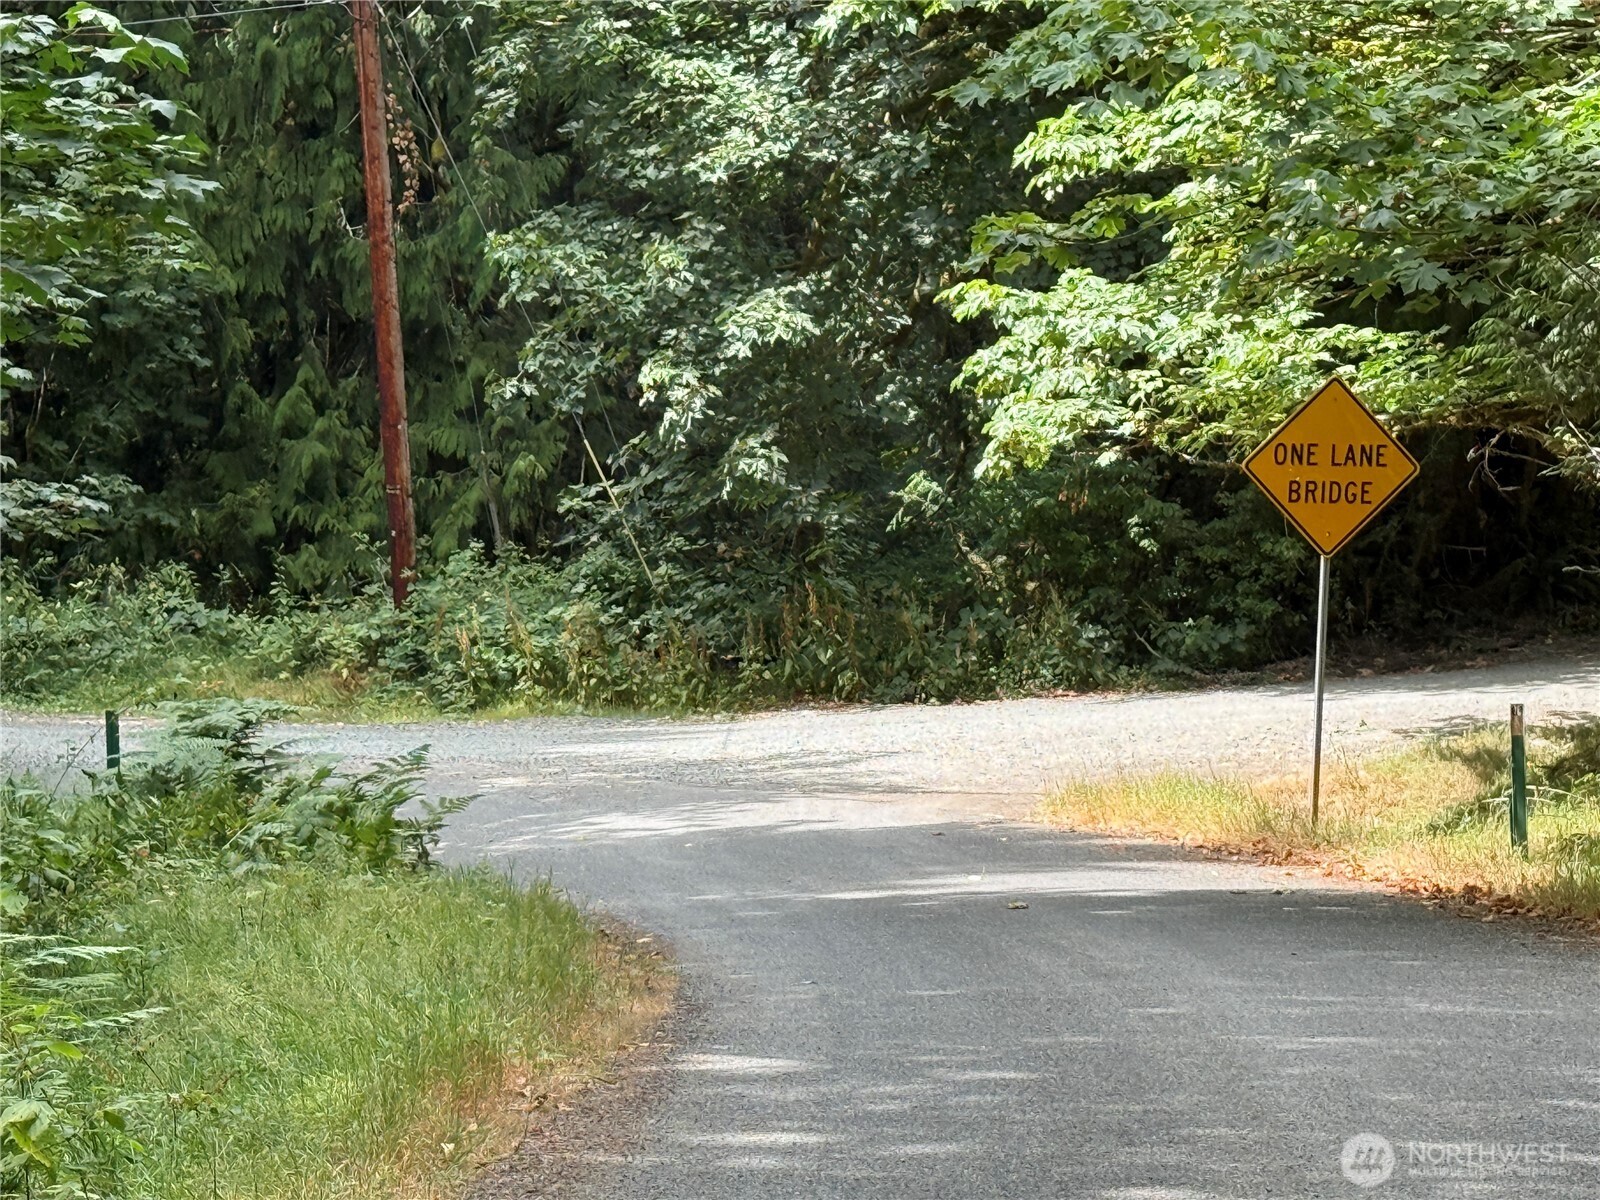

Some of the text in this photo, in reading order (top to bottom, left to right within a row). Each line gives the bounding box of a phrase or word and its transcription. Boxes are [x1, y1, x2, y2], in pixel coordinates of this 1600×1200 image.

[1273, 442, 1388, 468] ONE LANE
[1287, 480, 1374, 505] BRIDGE
